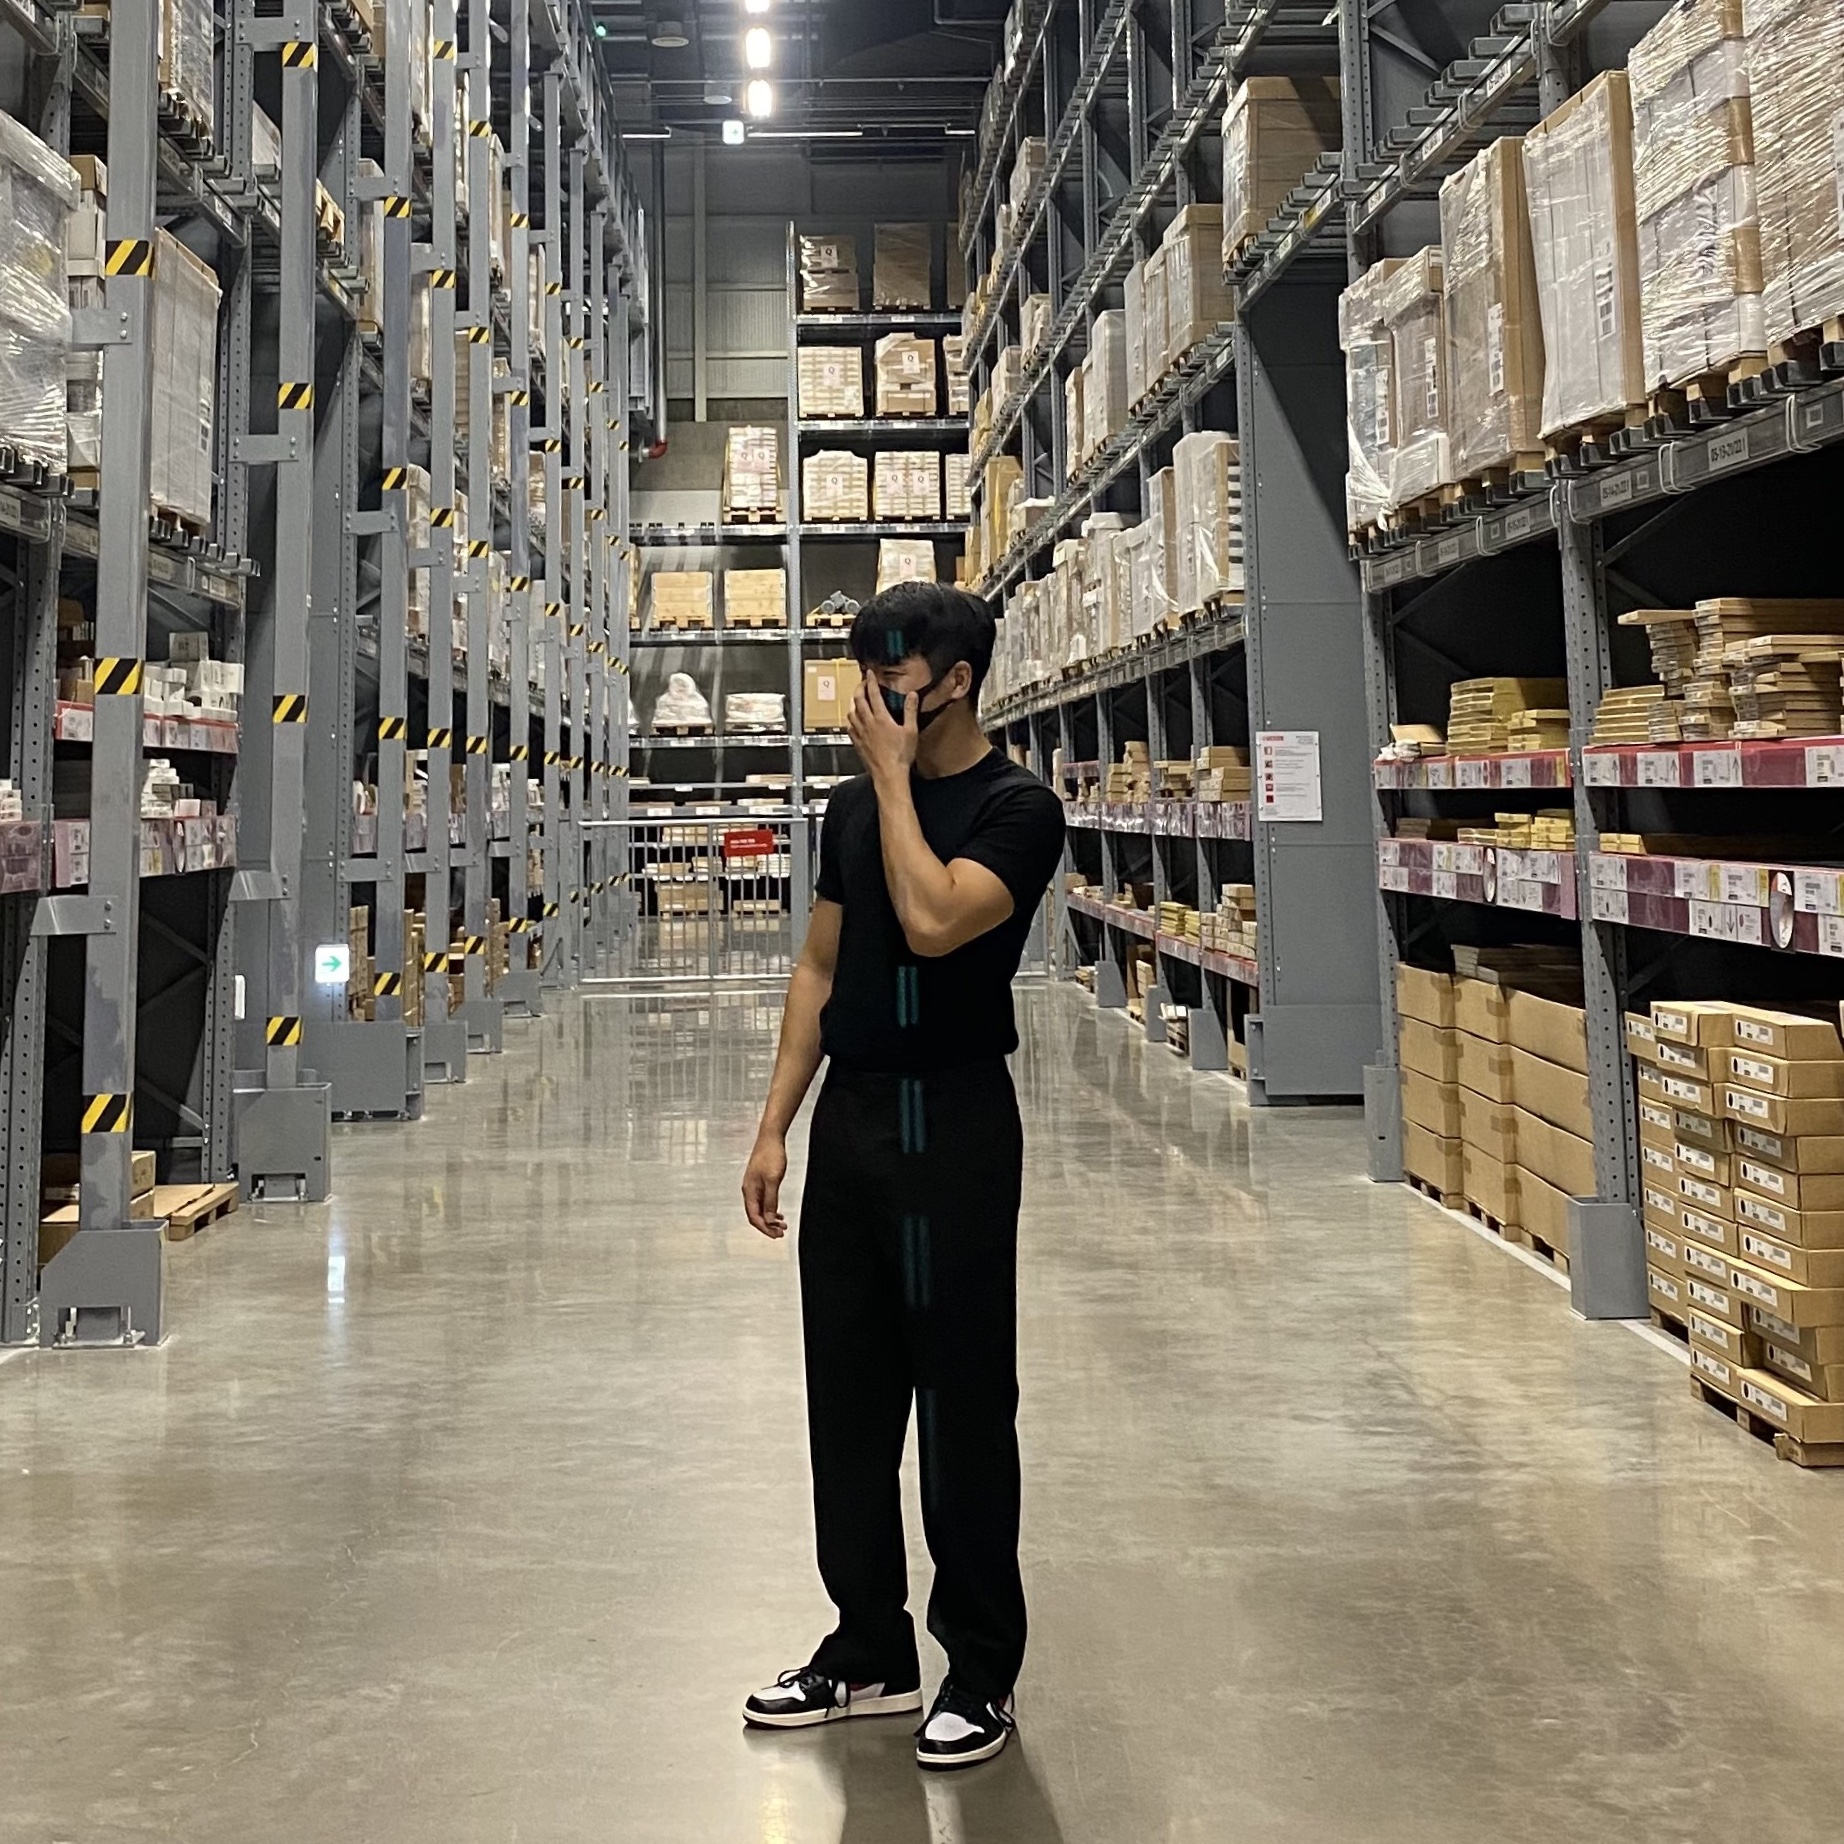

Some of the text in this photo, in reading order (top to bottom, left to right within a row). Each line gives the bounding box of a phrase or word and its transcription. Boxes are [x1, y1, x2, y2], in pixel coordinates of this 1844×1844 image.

[825, 247, 833, 256] Q
[907, 354, 914, 363] Q
[828, 366, 835, 375] Q
[831, 476, 838, 485] Q
[891, 474, 898, 483] Q
[917, 475, 924, 484] Q
[904, 557, 911, 566] Q
[823, 680, 830, 688] Q
